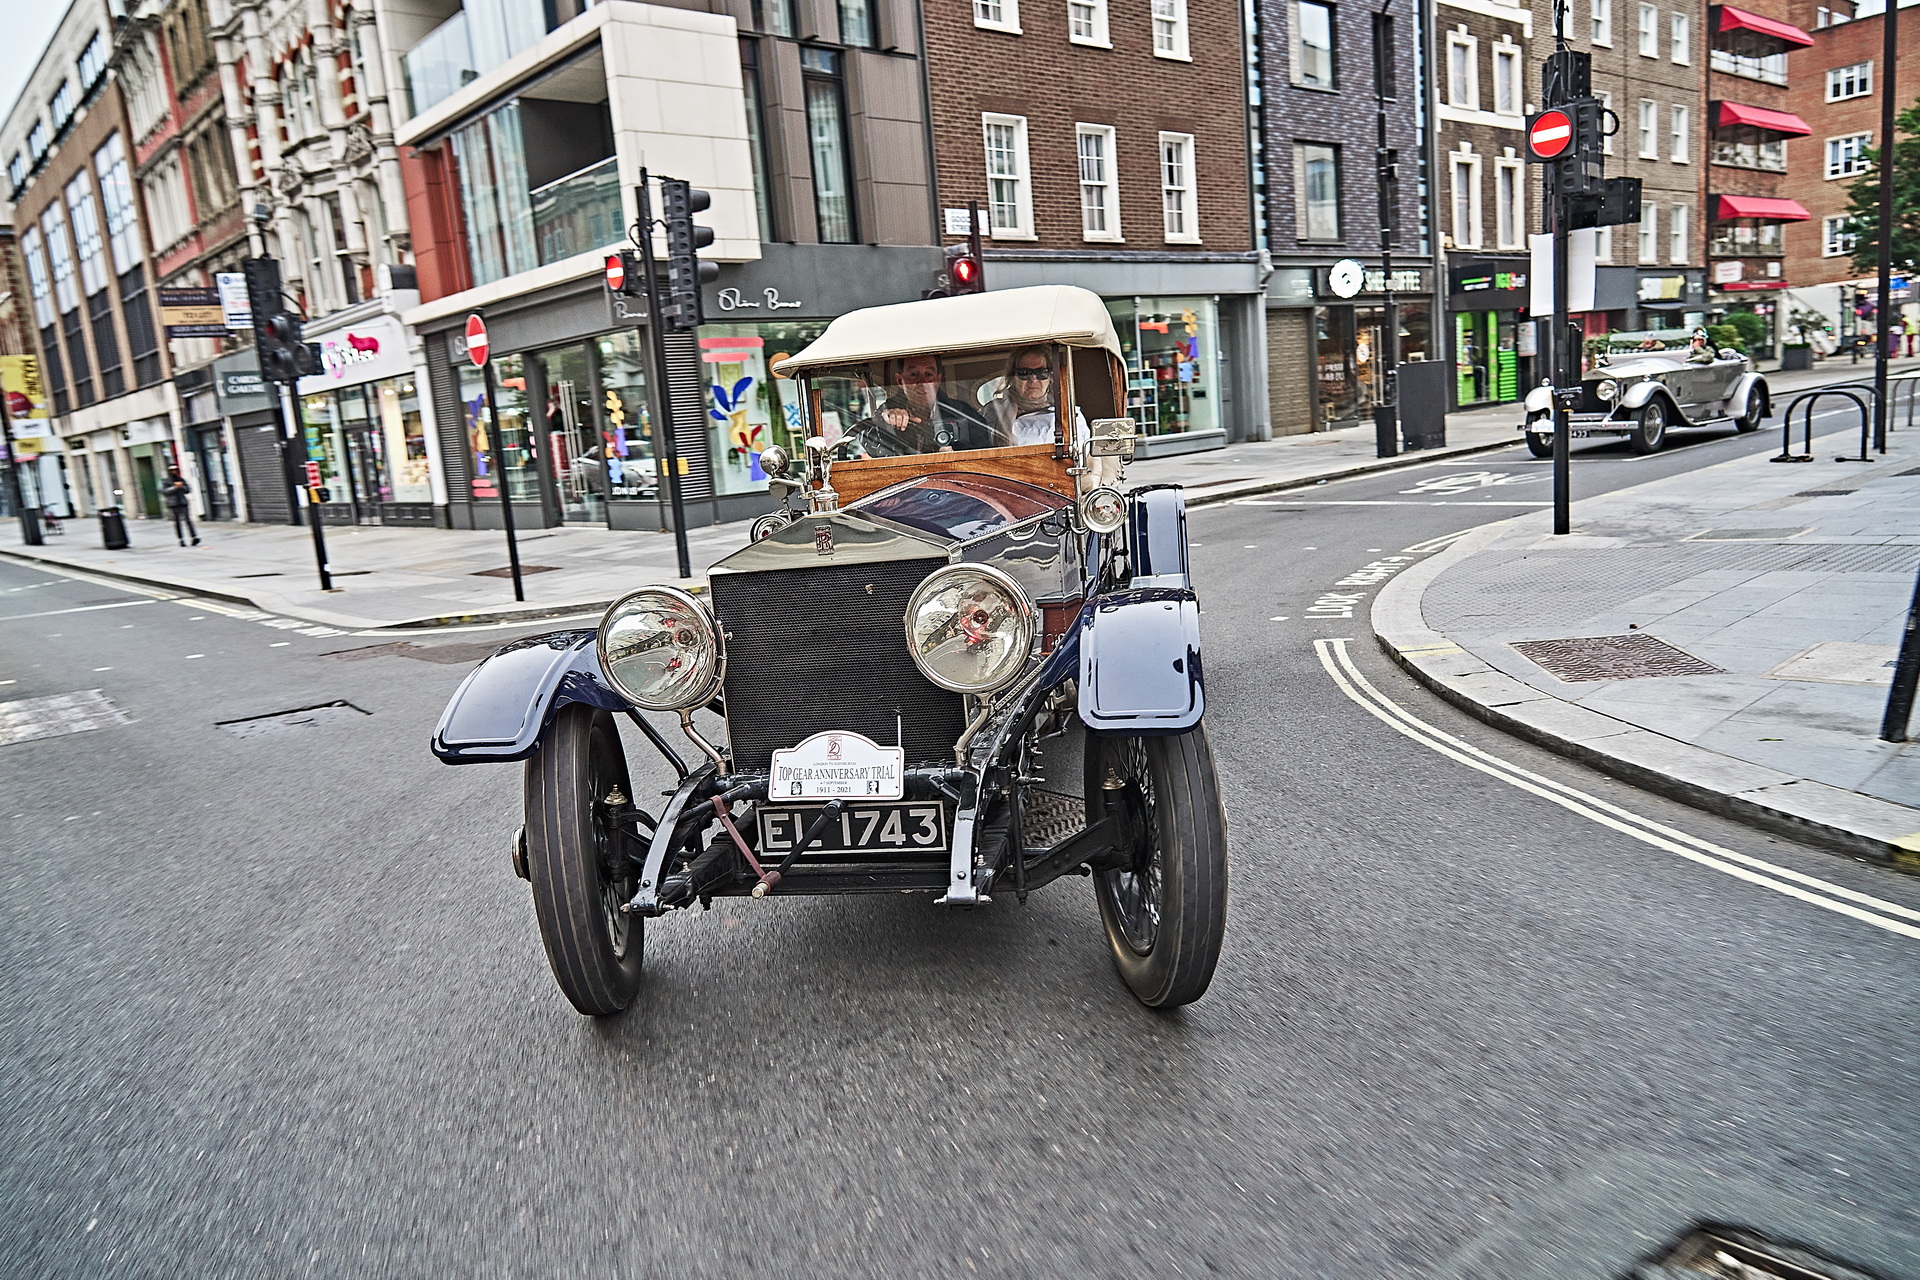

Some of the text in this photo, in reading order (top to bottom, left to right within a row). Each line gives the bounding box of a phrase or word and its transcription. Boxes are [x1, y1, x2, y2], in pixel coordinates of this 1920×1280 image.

[1303, 555, 1415, 619] LOOK RIGHT
[779, 764, 895, 781] TOP GEAR ANNIVERSARY TRIAL
[816, 786, 831, 794] 1911
[840, 808, 939, 848] 1743
